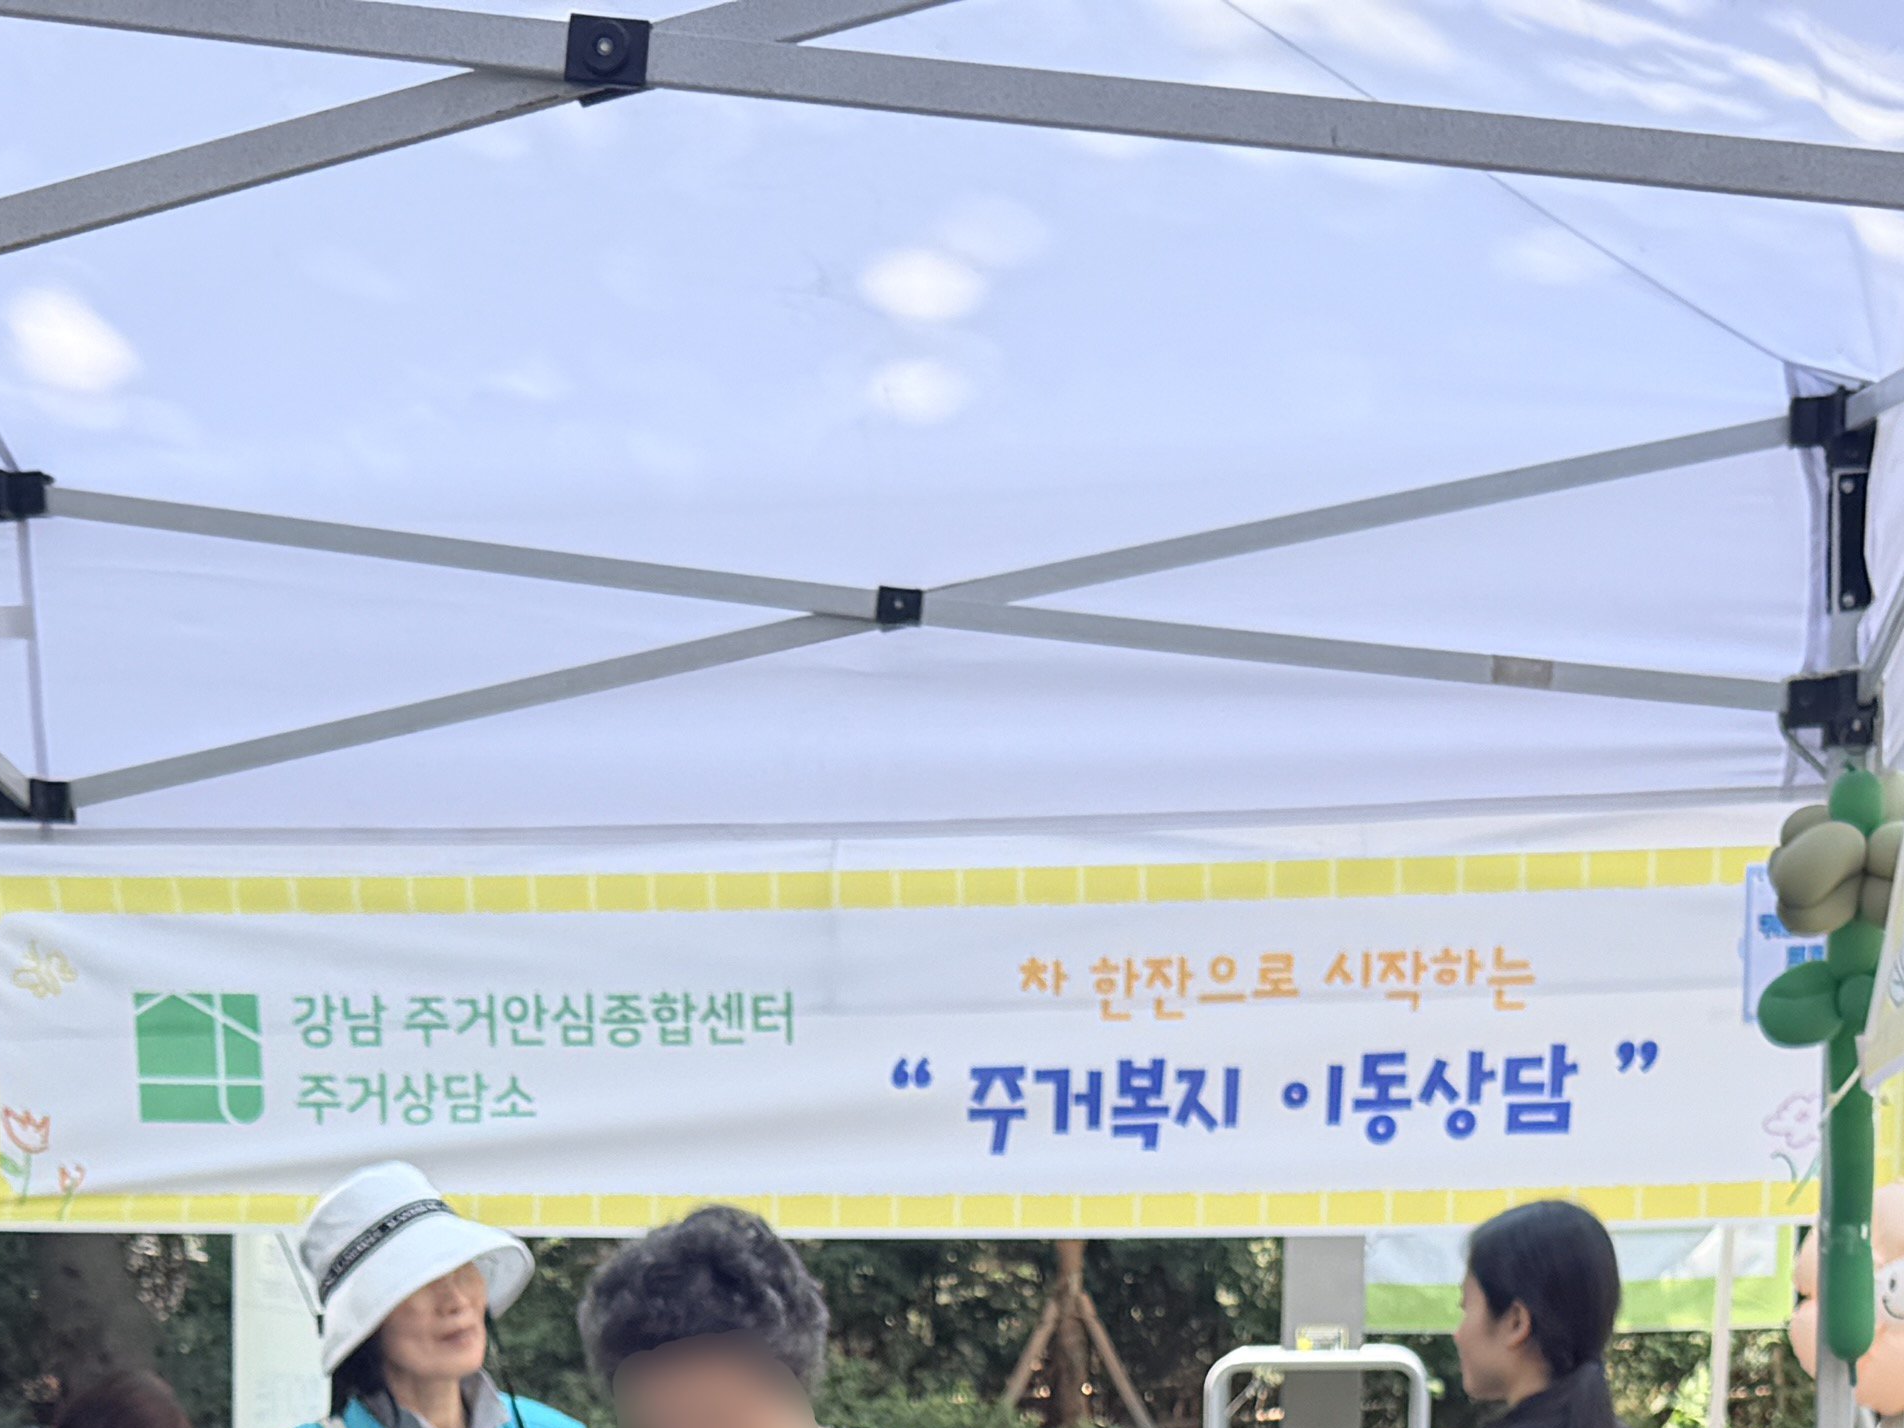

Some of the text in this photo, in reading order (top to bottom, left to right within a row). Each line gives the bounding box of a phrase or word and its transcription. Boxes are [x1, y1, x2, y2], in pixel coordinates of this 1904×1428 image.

[1017, 946, 1536, 1021] 차 한잔으로 시작하는
[293, 991, 794, 1049] 강남 주거안심종합센터
[296, 1071, 537, 1125] 주거상담소
[967, 1056, 1241, 1156] 주거복지
[1282, 1041, 1580, 1145] 이동상담
